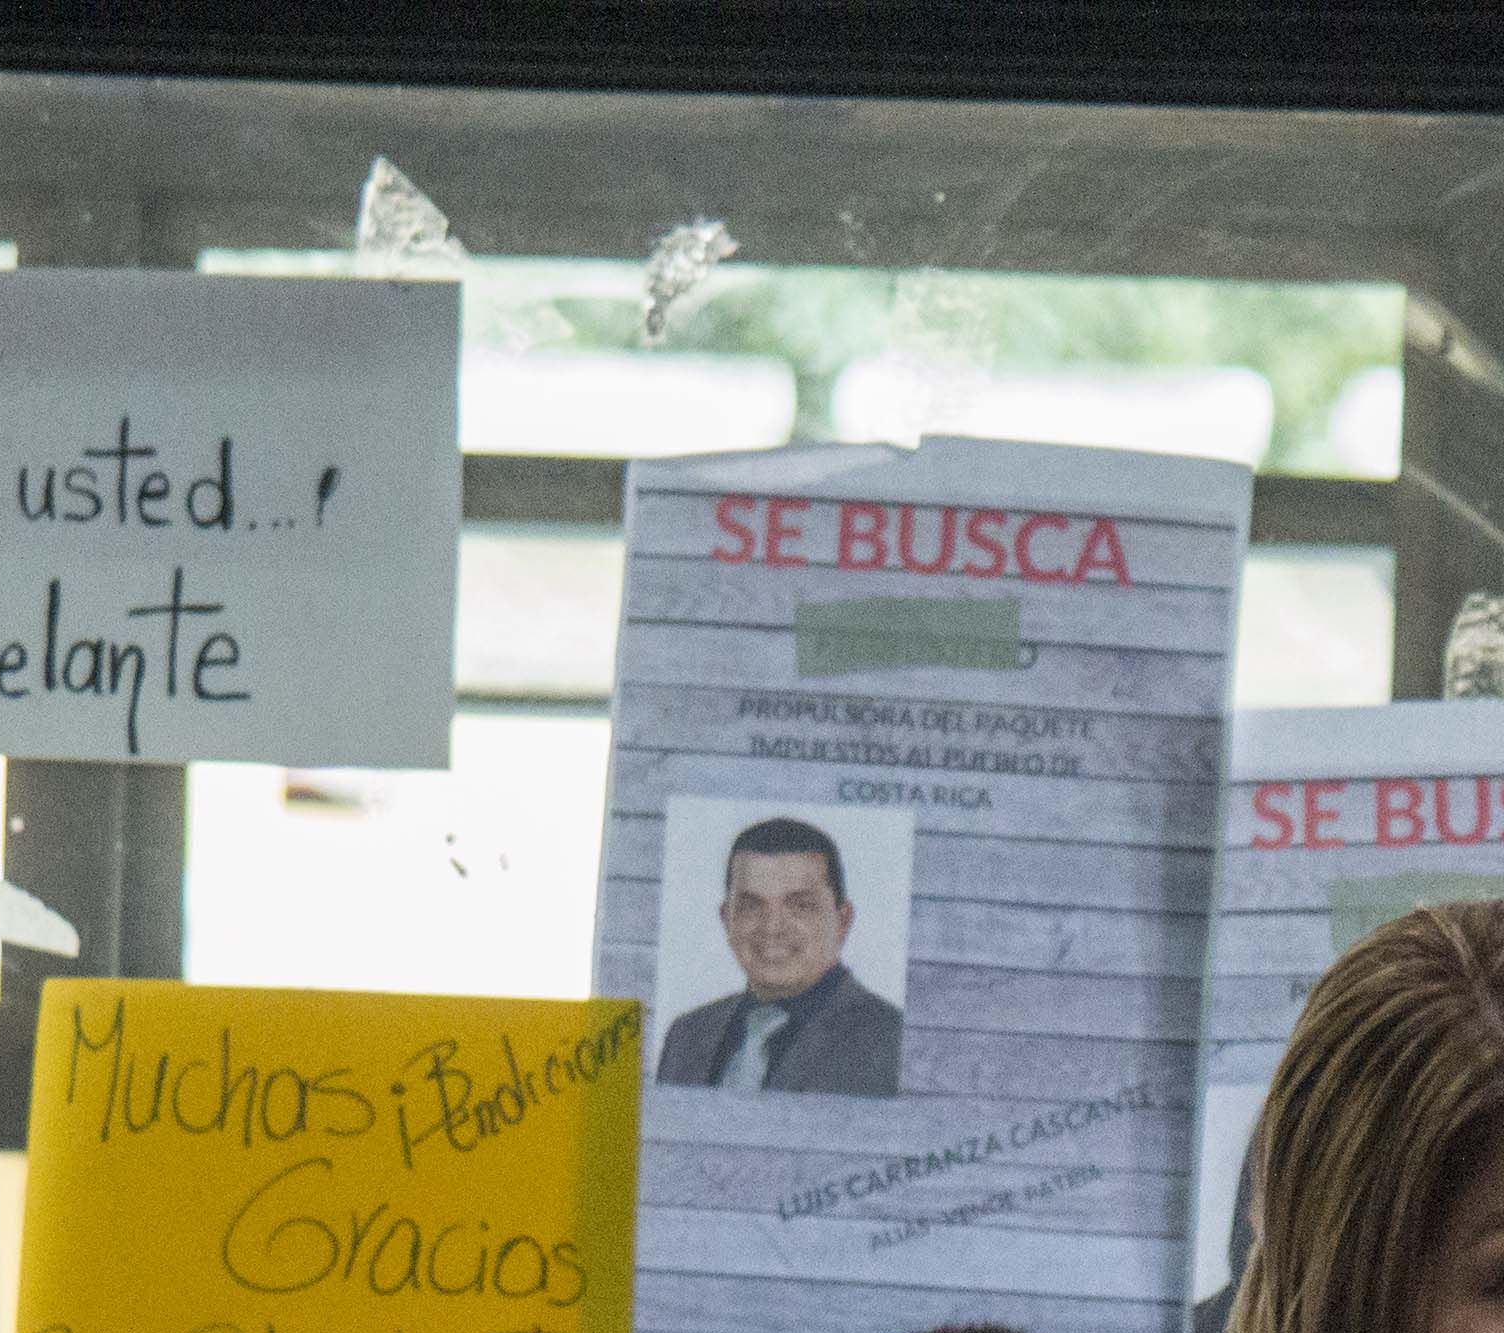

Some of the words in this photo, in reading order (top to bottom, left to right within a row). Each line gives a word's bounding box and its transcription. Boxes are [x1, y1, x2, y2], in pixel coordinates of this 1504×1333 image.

[712, 494, 810, 567] SE
[837, 502, 1135, 590] BUSCA
[737, 698, 915, 729] PROPULSORA
[921, 707, 970, 733] DEL
[975, 711, 1097, 741] PAQUETE
[751, 736, 897, 768] IMPUESTOS
[838, 778, 926, 805] COSTA
[933, 783, 993, 809] RICA
[1250, 780, 1347, 851] SE
[67, 998, 376, 1146] Muchas
[777, 1182, 839, 1223] LUIS
[845, 1132, 1003, 1200] CARRANZA
[1011, 1081, 1158, 1149] CASCANTE
[223, 1158, 588, 1307] Gracias
